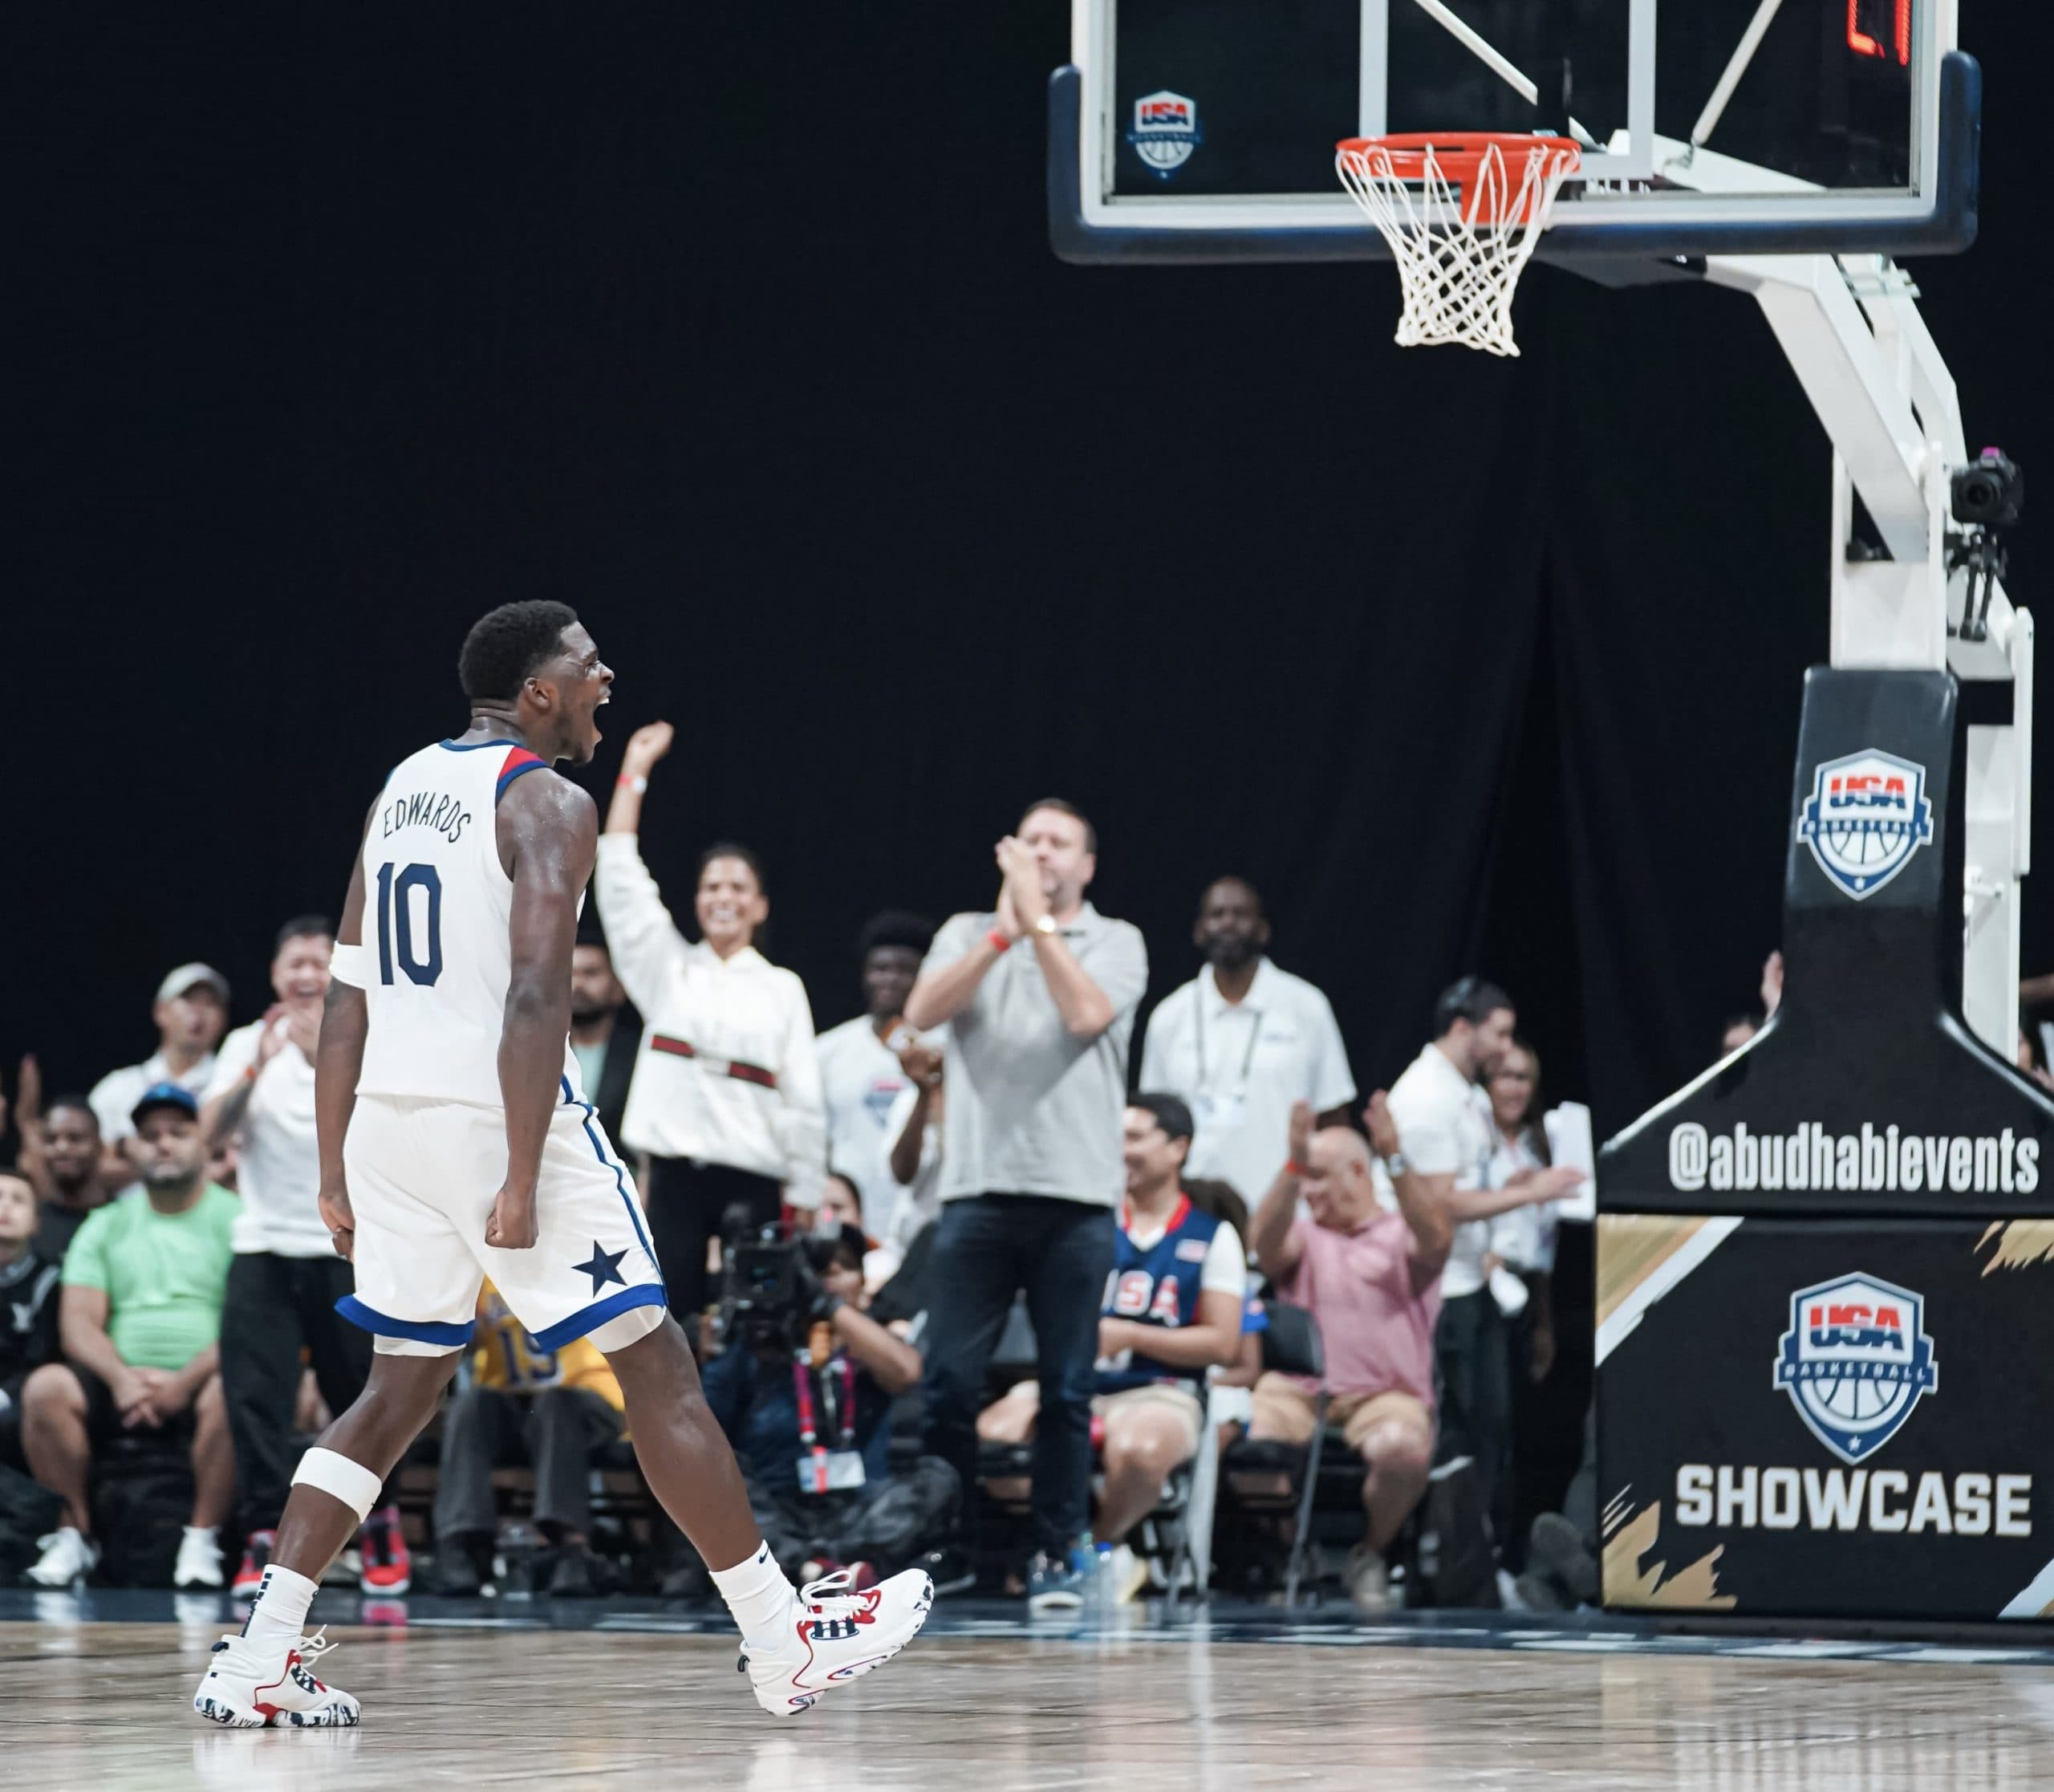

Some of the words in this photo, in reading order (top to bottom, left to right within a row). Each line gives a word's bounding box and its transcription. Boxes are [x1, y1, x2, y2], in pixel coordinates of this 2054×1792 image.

[1141, 103, 1188, 126] USA
[384, 791, 471, 843] EDWARDS
[1830, 776, 1906, 809] USA
[377, 862, 443, 987] 10
[1669, 1122, 2040, 1193] @abudhabievents
[1810, 1303, 1904, 1351] USA
[1676, 1464, 2032, 1536] SHOWCASE
